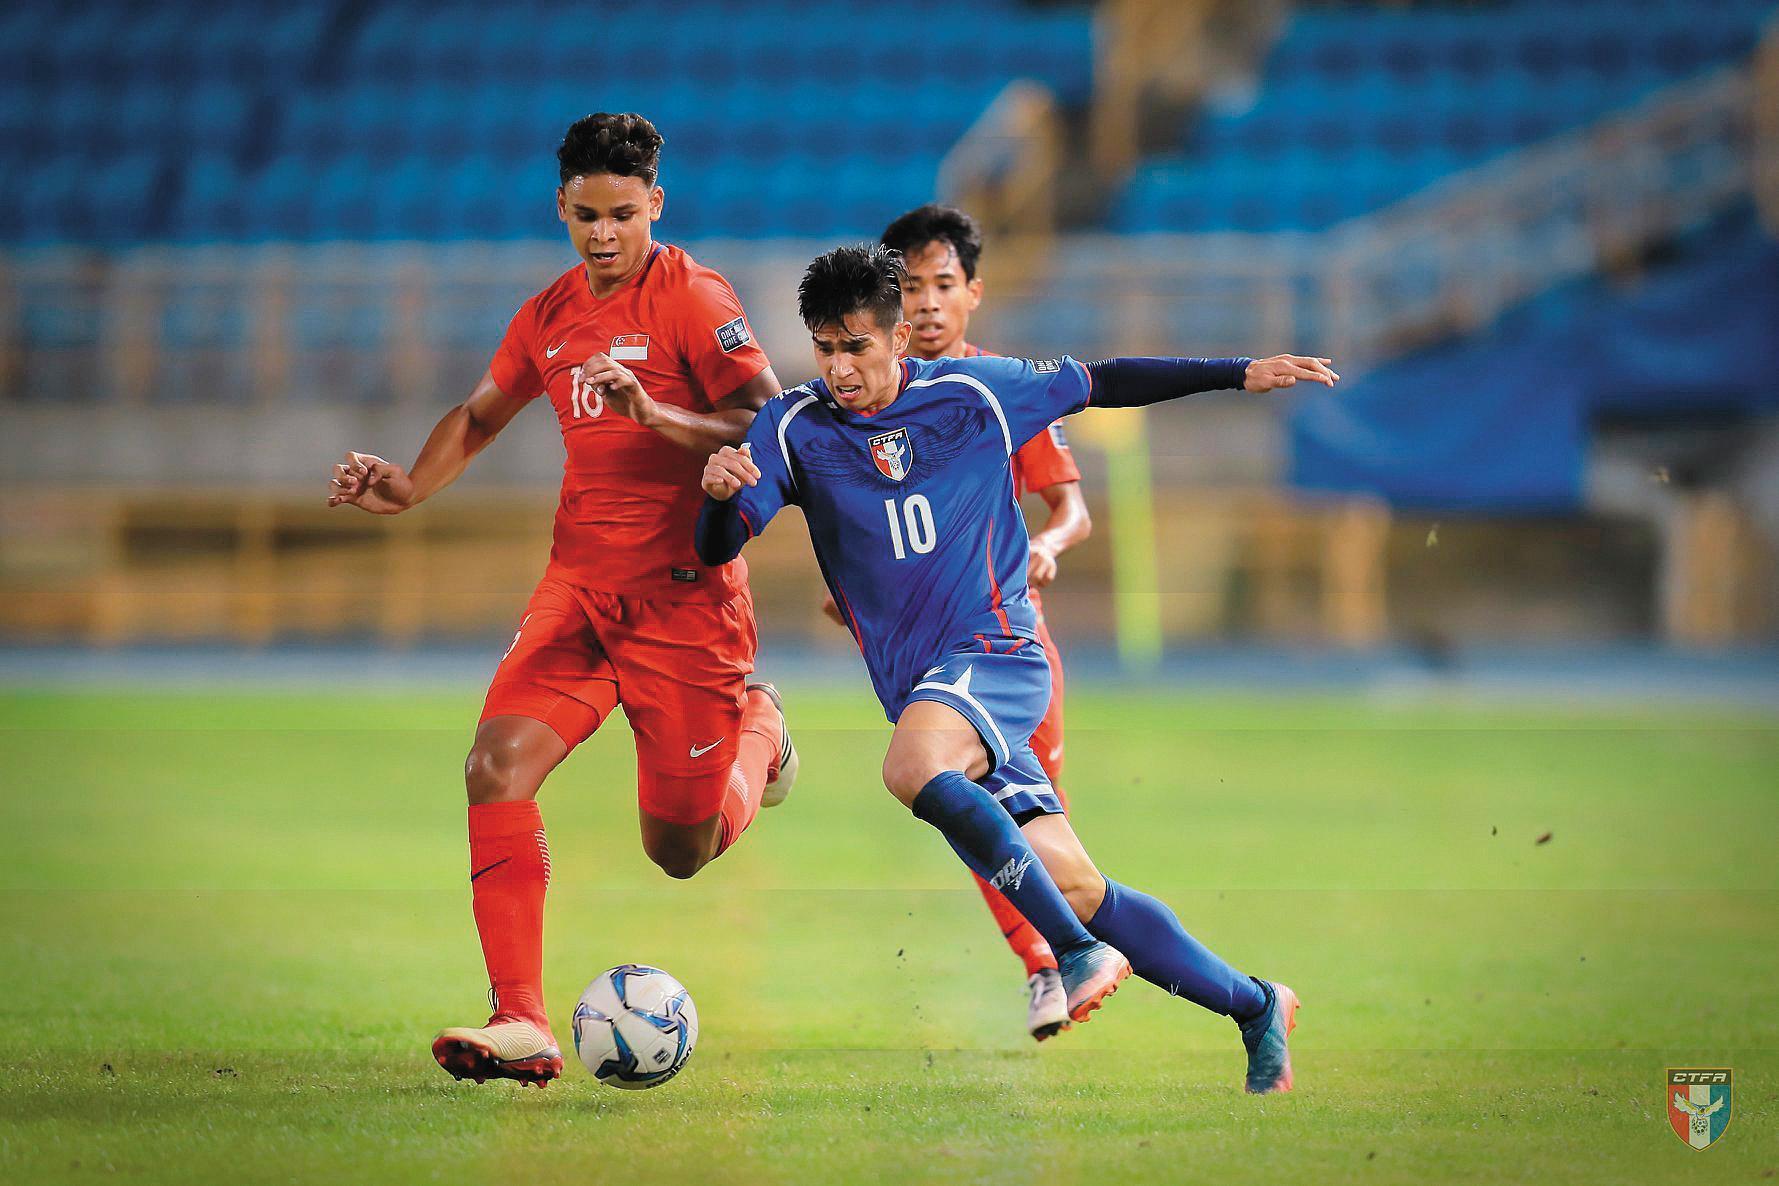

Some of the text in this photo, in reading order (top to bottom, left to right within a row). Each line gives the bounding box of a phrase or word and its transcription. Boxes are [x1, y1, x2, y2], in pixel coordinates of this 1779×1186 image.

[720, 327, 735, 339] ONE
[723, 335, 738, 347] ONE
[872, 431, 903, 446] CTFA
[884, 494, 937, 559] 10
